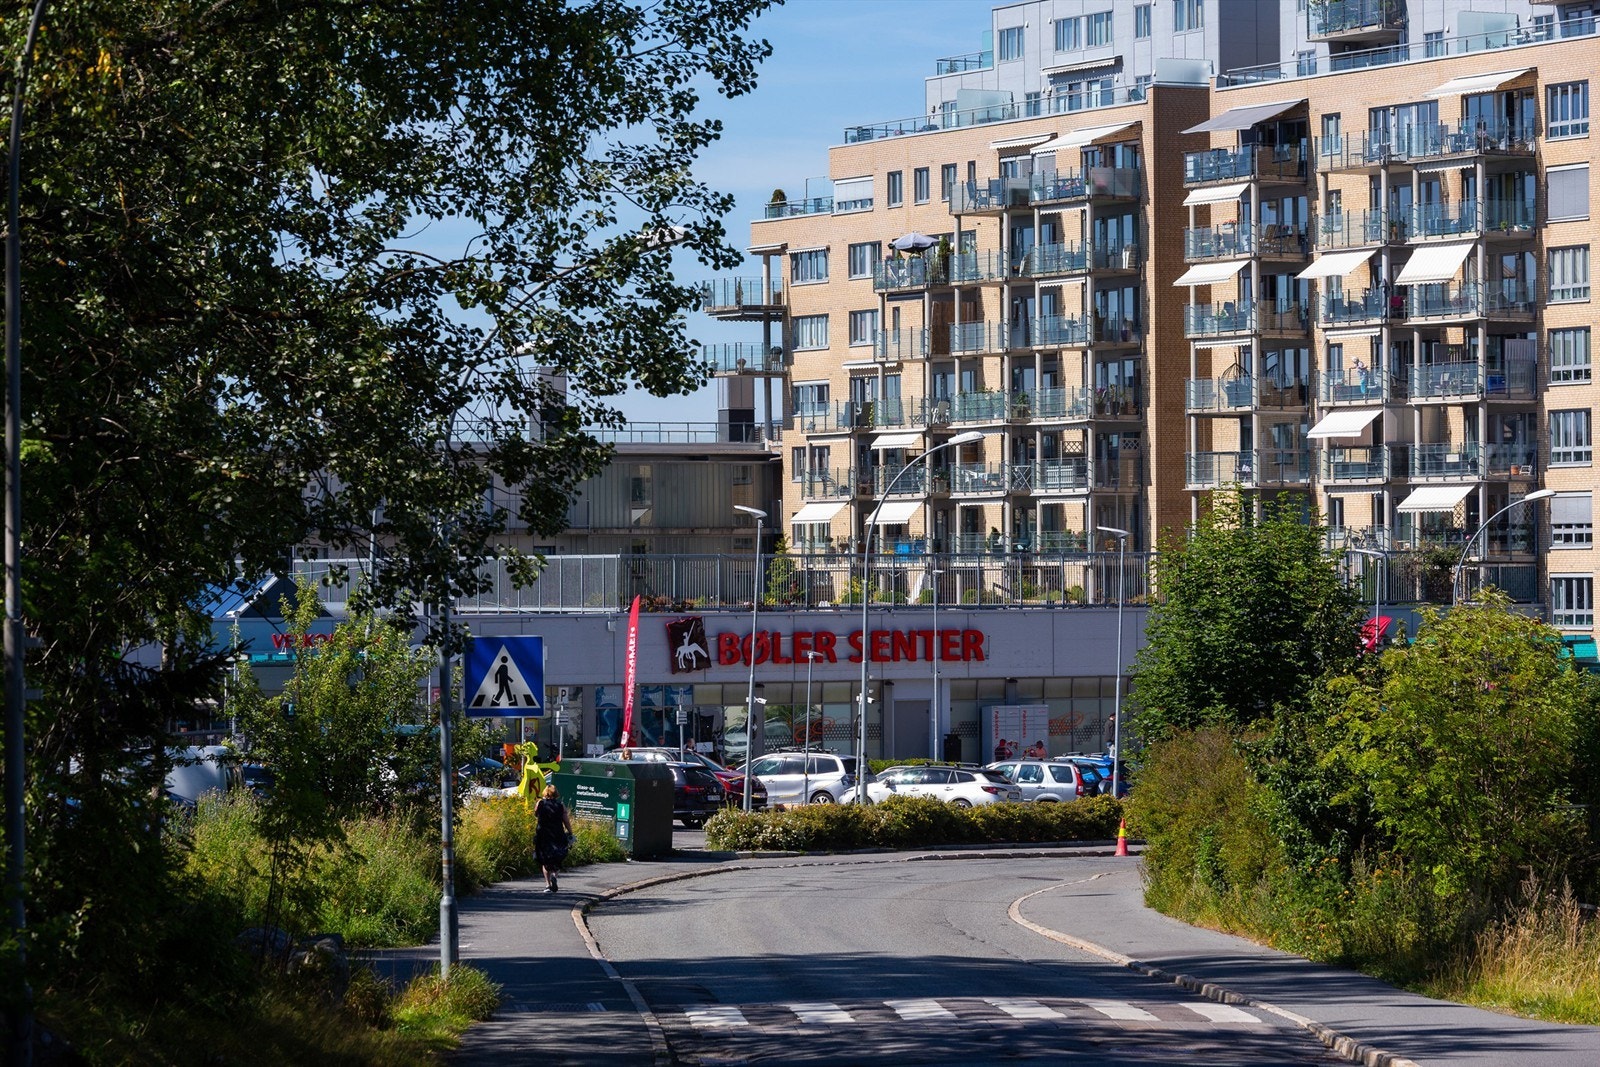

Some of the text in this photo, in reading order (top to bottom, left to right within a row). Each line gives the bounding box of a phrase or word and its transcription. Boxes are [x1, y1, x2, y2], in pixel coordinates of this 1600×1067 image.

[718, 629, 986, 667] BØLER SENTER
[561, 689, 567, 702] P
